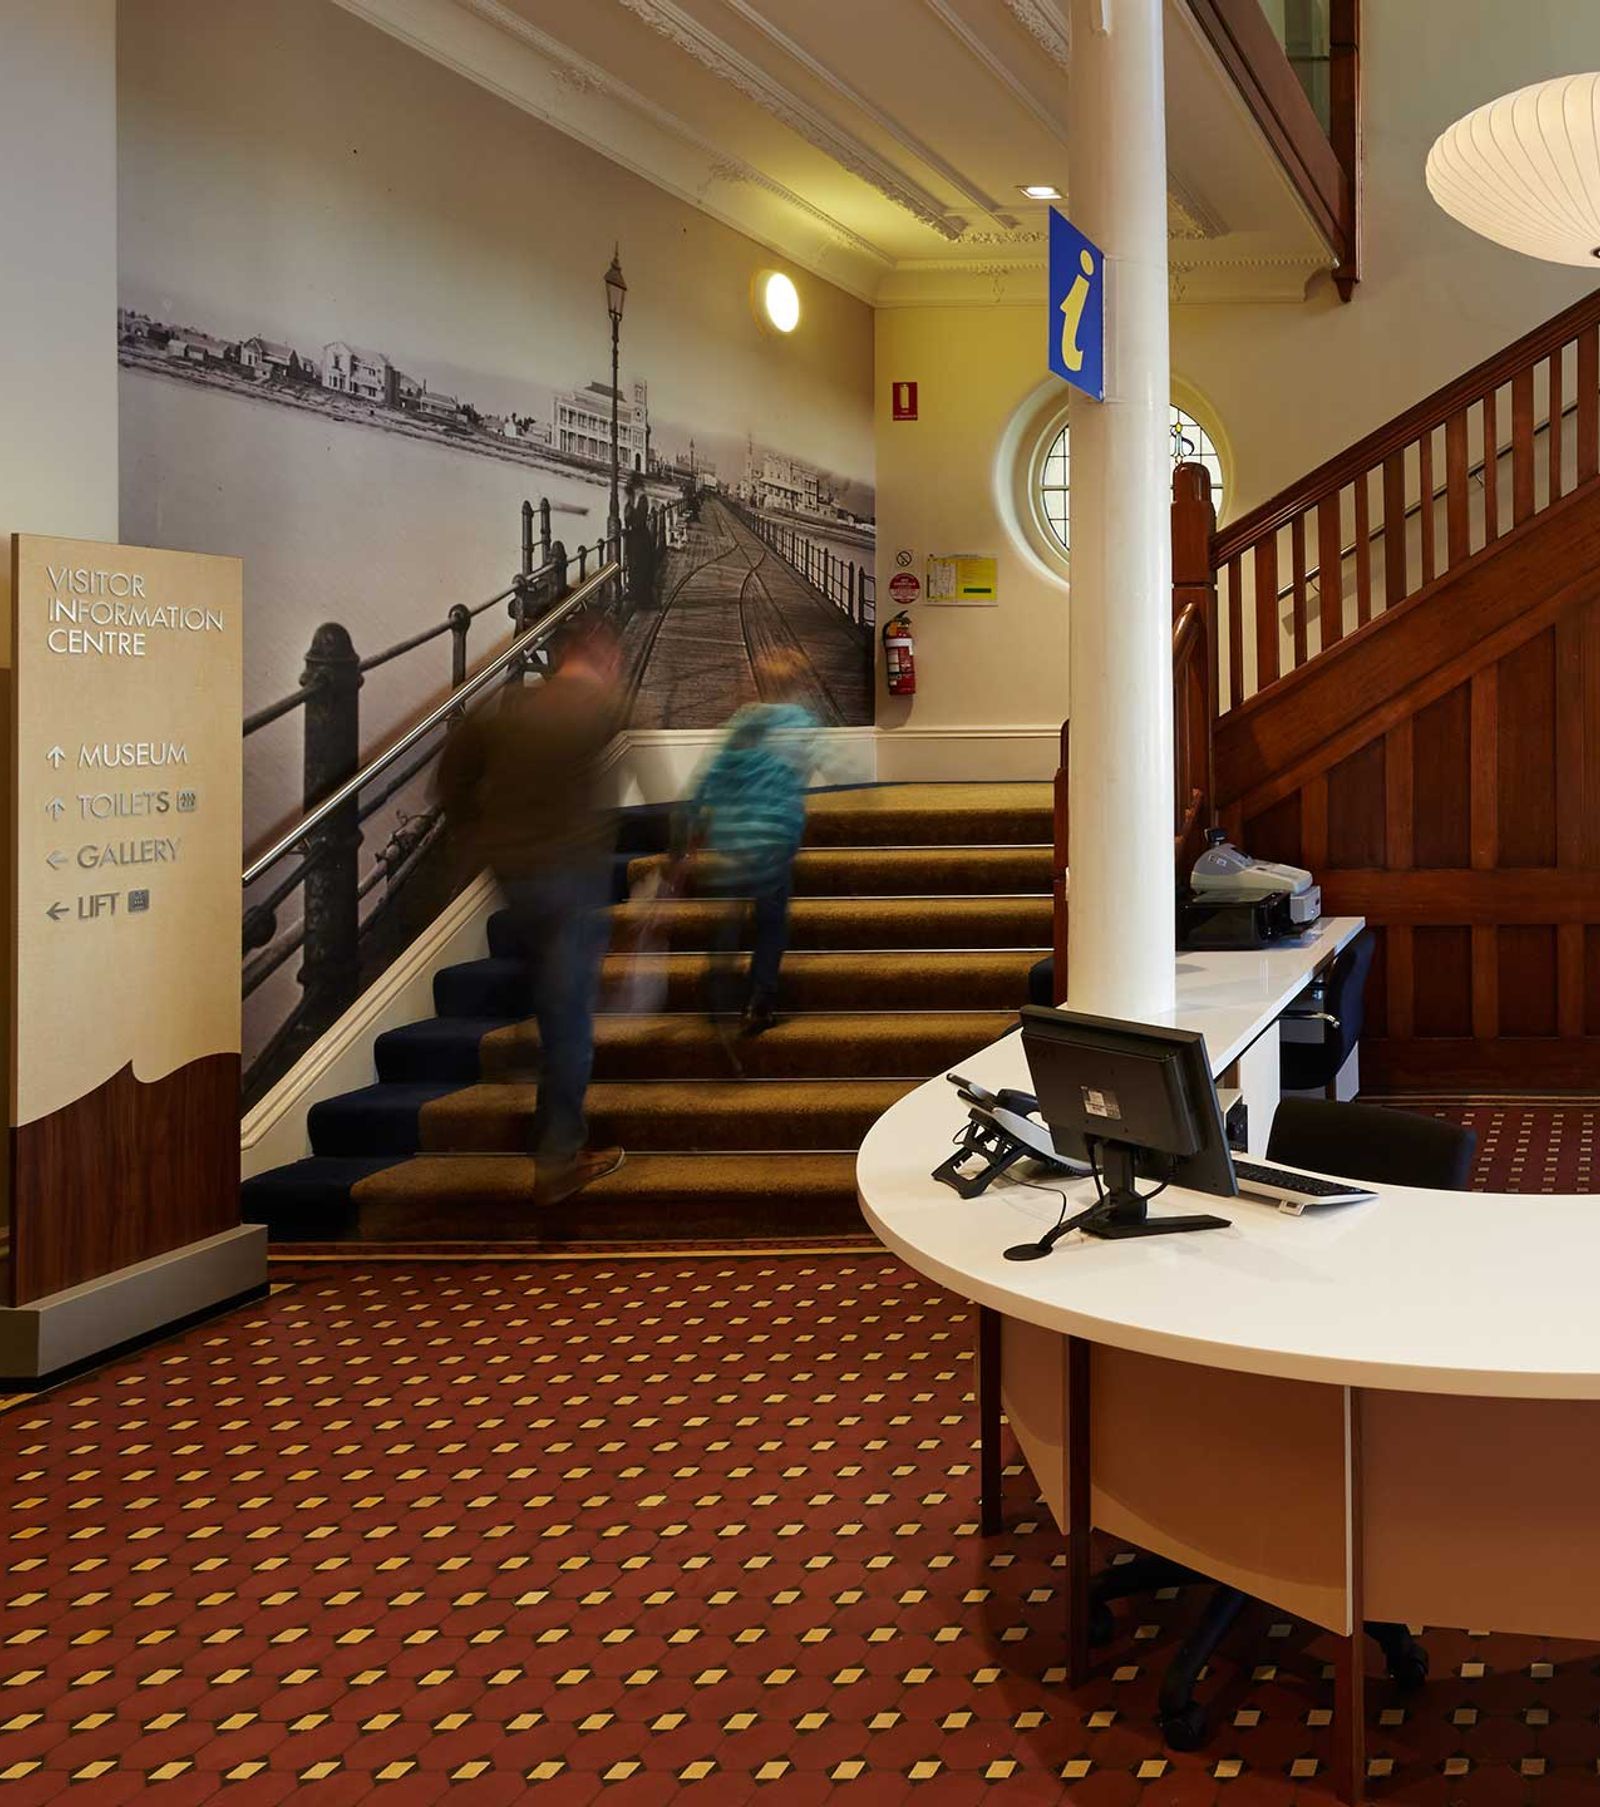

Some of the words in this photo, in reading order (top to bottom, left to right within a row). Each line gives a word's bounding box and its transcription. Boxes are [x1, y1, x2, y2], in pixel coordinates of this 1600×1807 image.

[46, 566, 145, 598] VISITOR
[48, 598, 224, 632] INFORMATION
[47, 628, 146, 656] CENTRE
[78, 742, 189, 769] MUSEUM
[76, 791, 170, 820] TOILETS
[77, 838, 181, 869] GALLERY
[78, 891, 120, 920] LIFT
